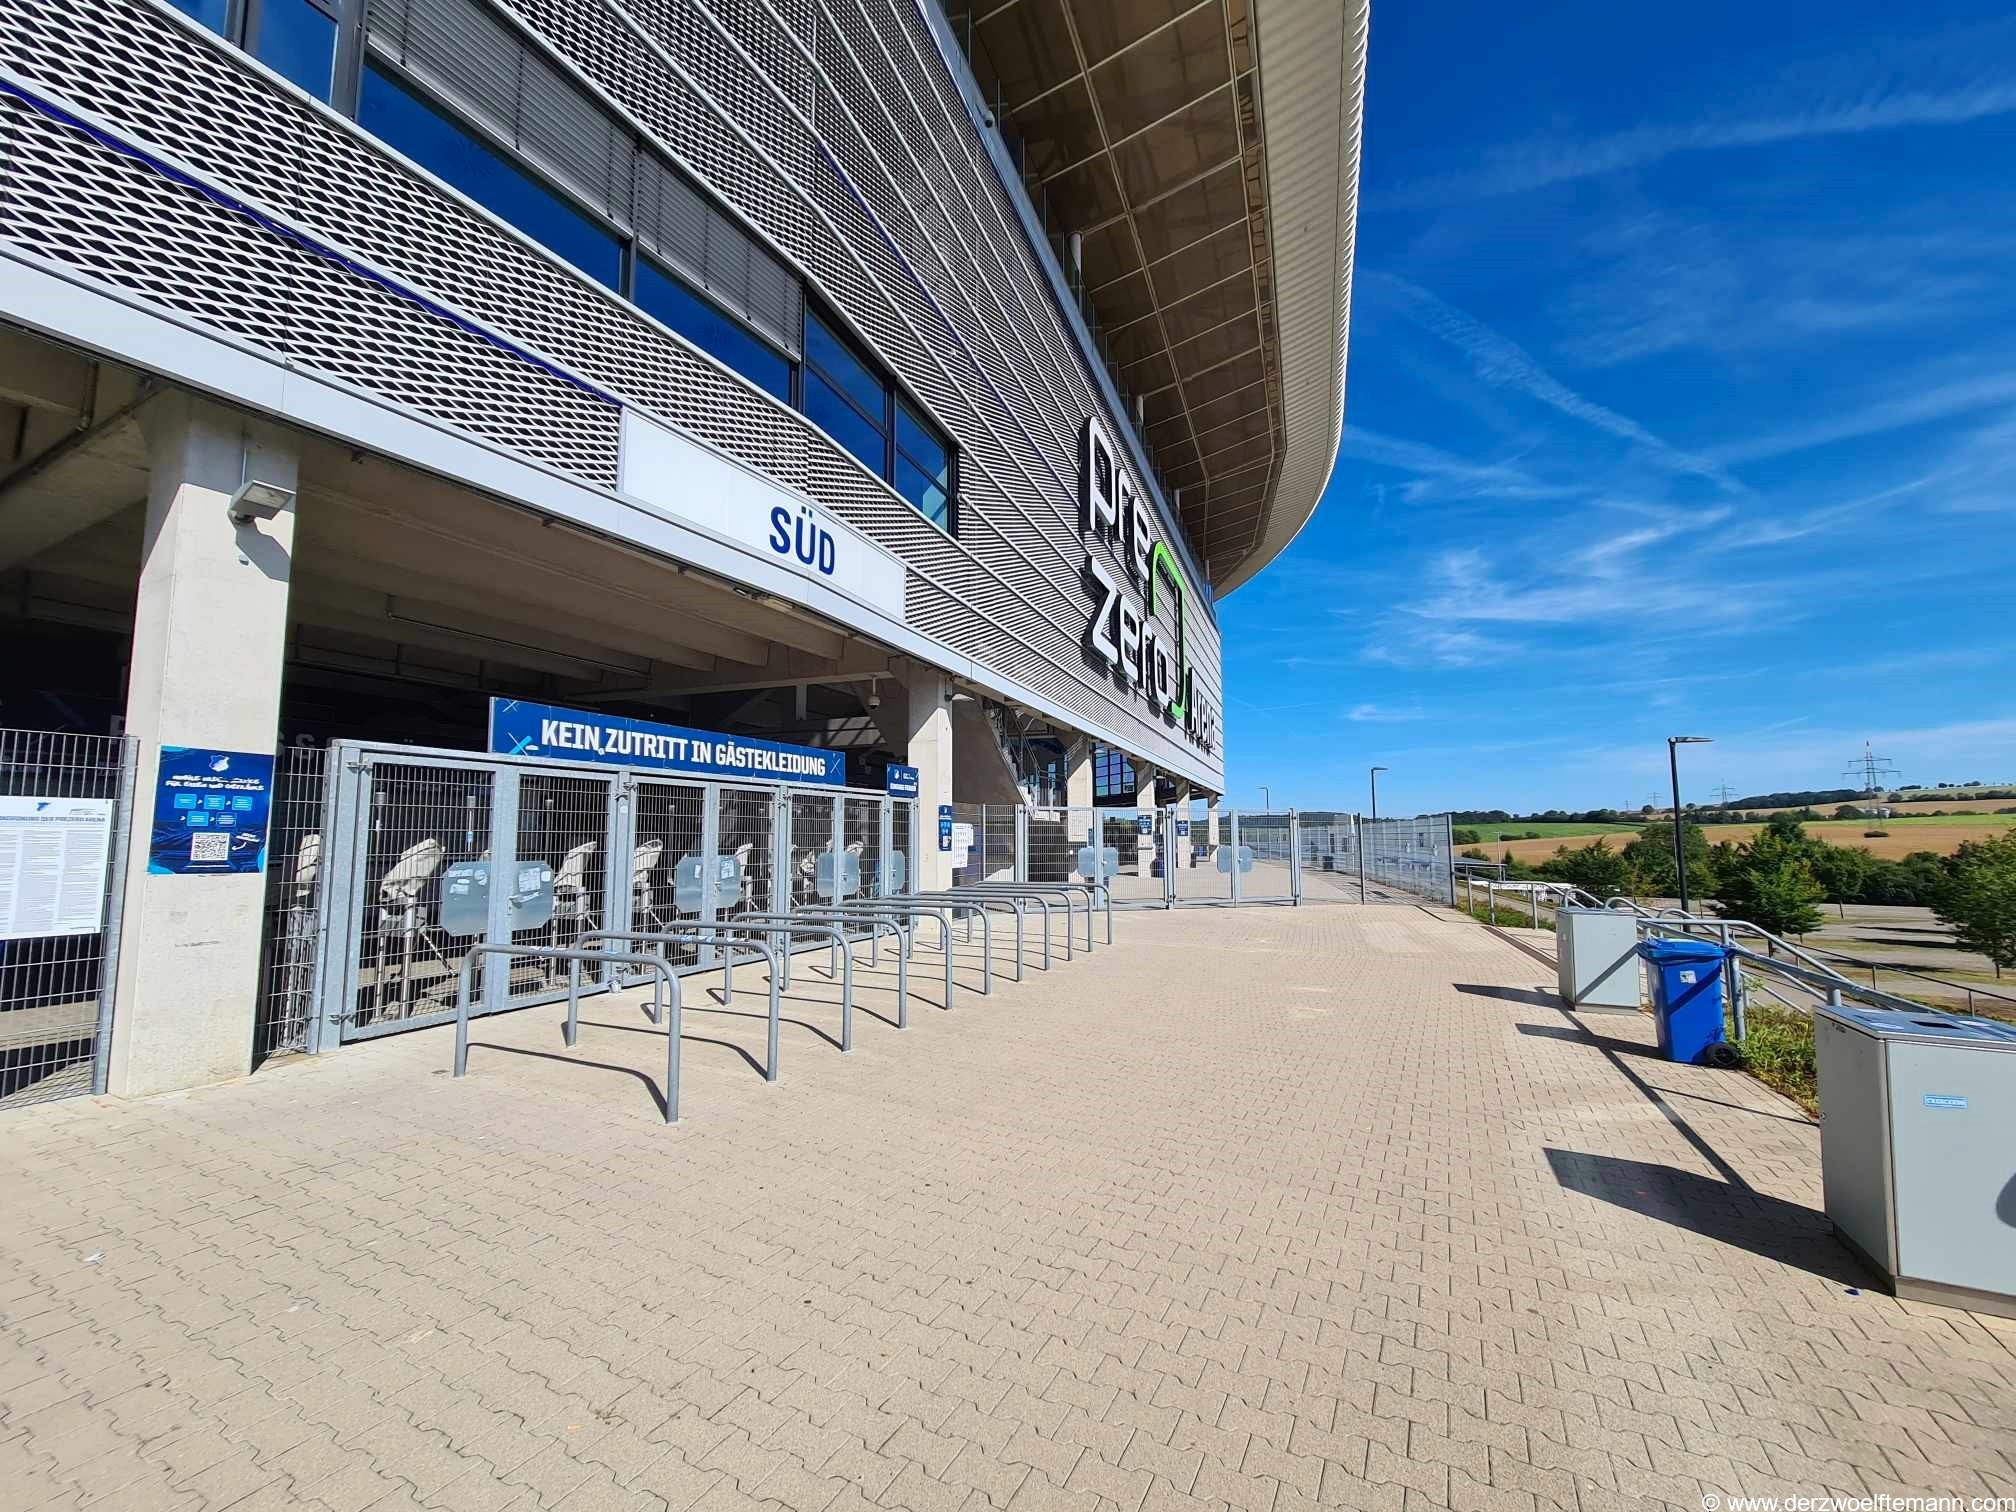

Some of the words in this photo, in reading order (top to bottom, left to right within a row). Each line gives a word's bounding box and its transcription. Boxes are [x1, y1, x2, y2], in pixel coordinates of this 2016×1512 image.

[769, 505, 835, 575] SÜD
[1089, 416, 1150, 581] Pre
[1091, 556, 1171, 706] Zero
[541, 719, 600, 750] KEIN
[605, 730, 688, 762] ZUTRITT
[691, 740, 711, 764] IN
[715, 742, 826, 777] GÄSTEKLEIDUNG
